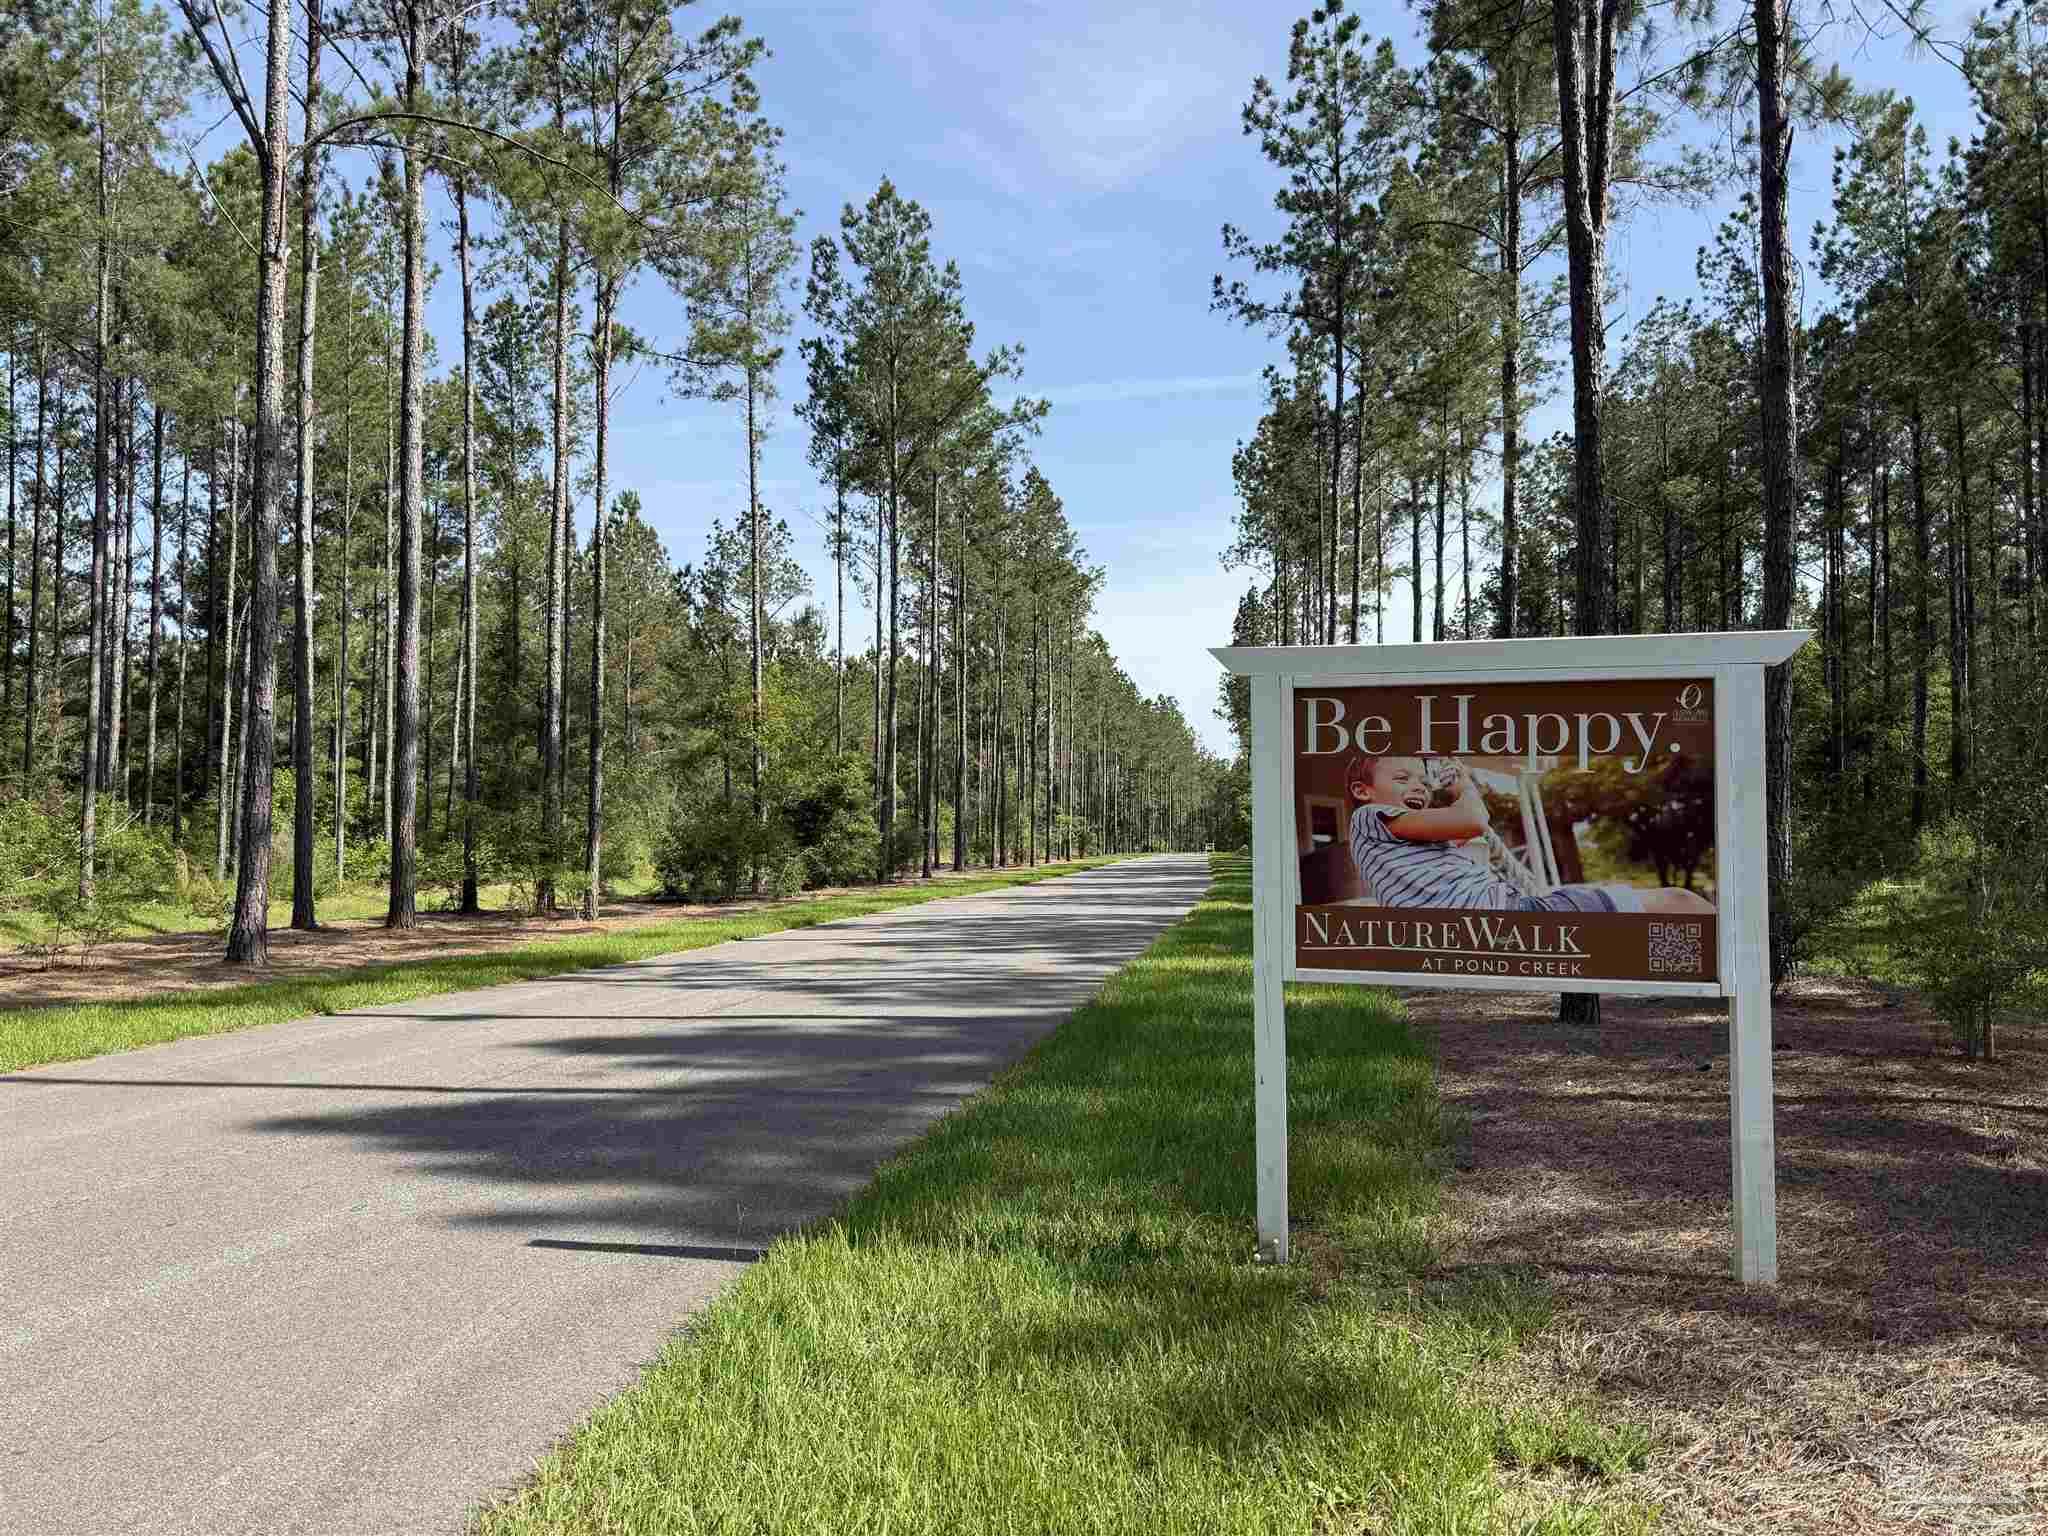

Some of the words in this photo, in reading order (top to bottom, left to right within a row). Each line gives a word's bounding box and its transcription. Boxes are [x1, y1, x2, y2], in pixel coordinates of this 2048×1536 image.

[1301, 696, 1393, 756] Be
[1414, 694, 1681, 775] Happy.
[1421, 957, 1445, 972] AT
[1454, 959, 1511, 974] POND
[1519, 961, 1584, 976] CREEK
